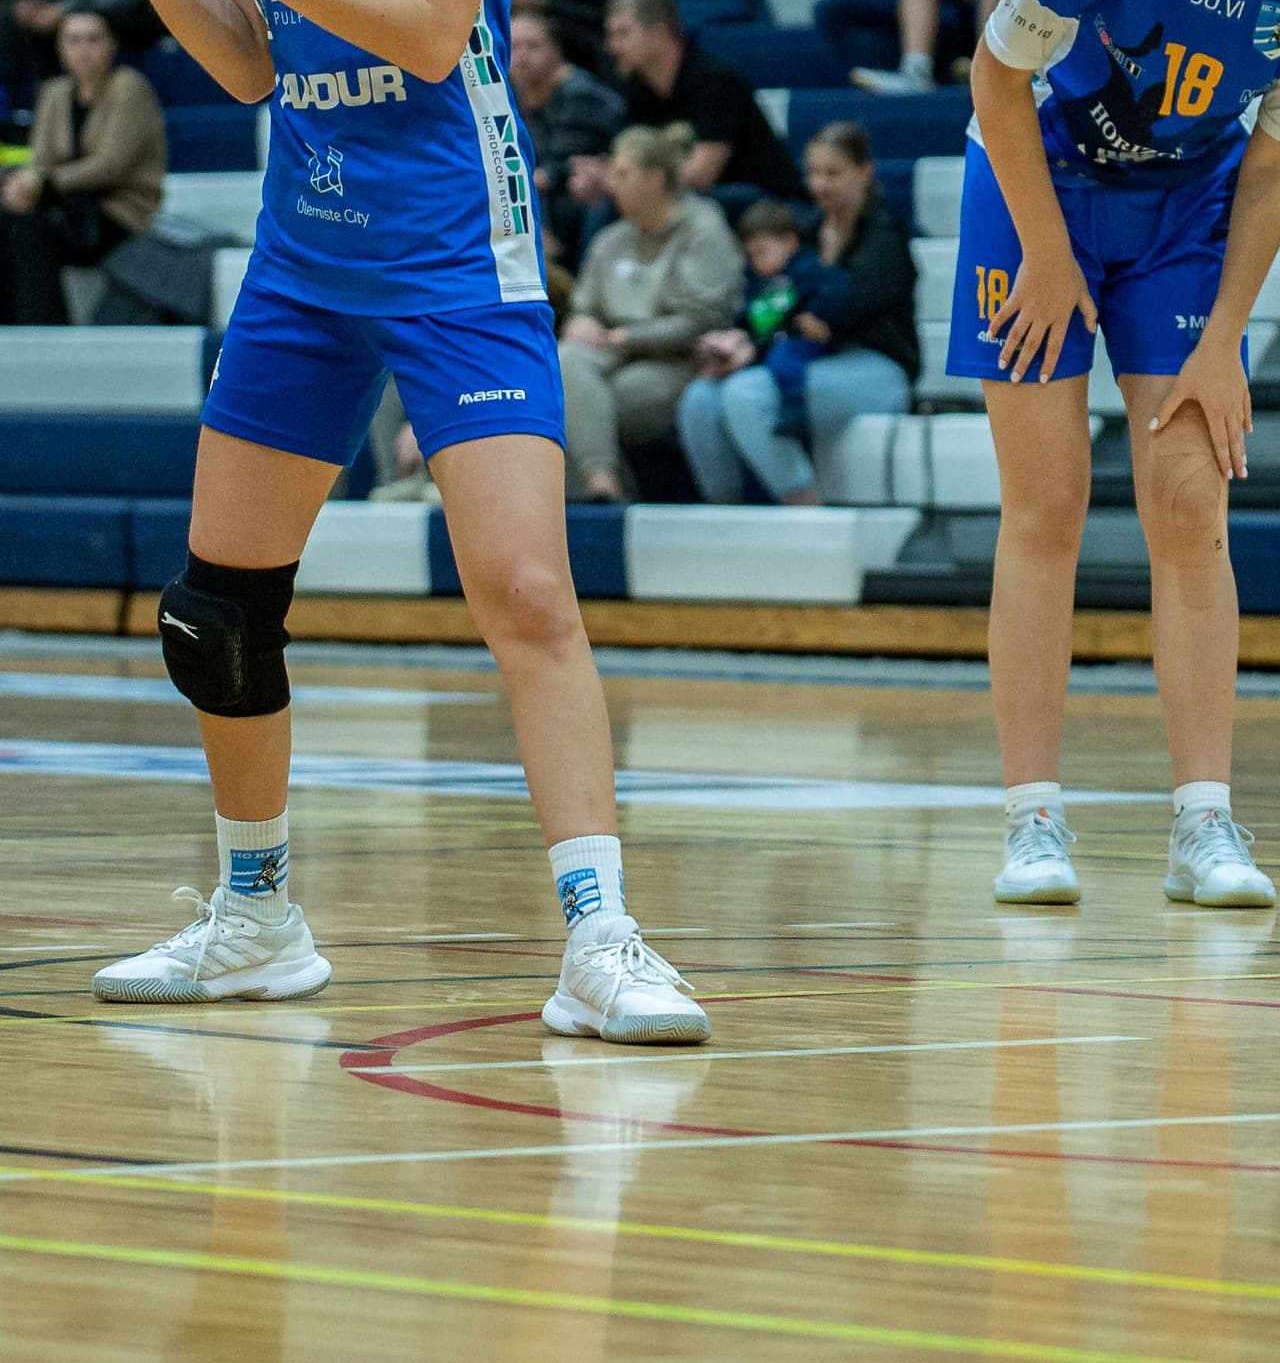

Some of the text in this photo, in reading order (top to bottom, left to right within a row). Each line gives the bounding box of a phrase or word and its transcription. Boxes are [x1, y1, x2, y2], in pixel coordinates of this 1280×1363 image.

[275, 65, 407, 110] AADUR
[1158, 42, 1224, 117] 18
[482, 116, 512, 237] NORDECON BETOON
[344, 208, 370, 228] City
[976, 265, 1009, 323] 18
